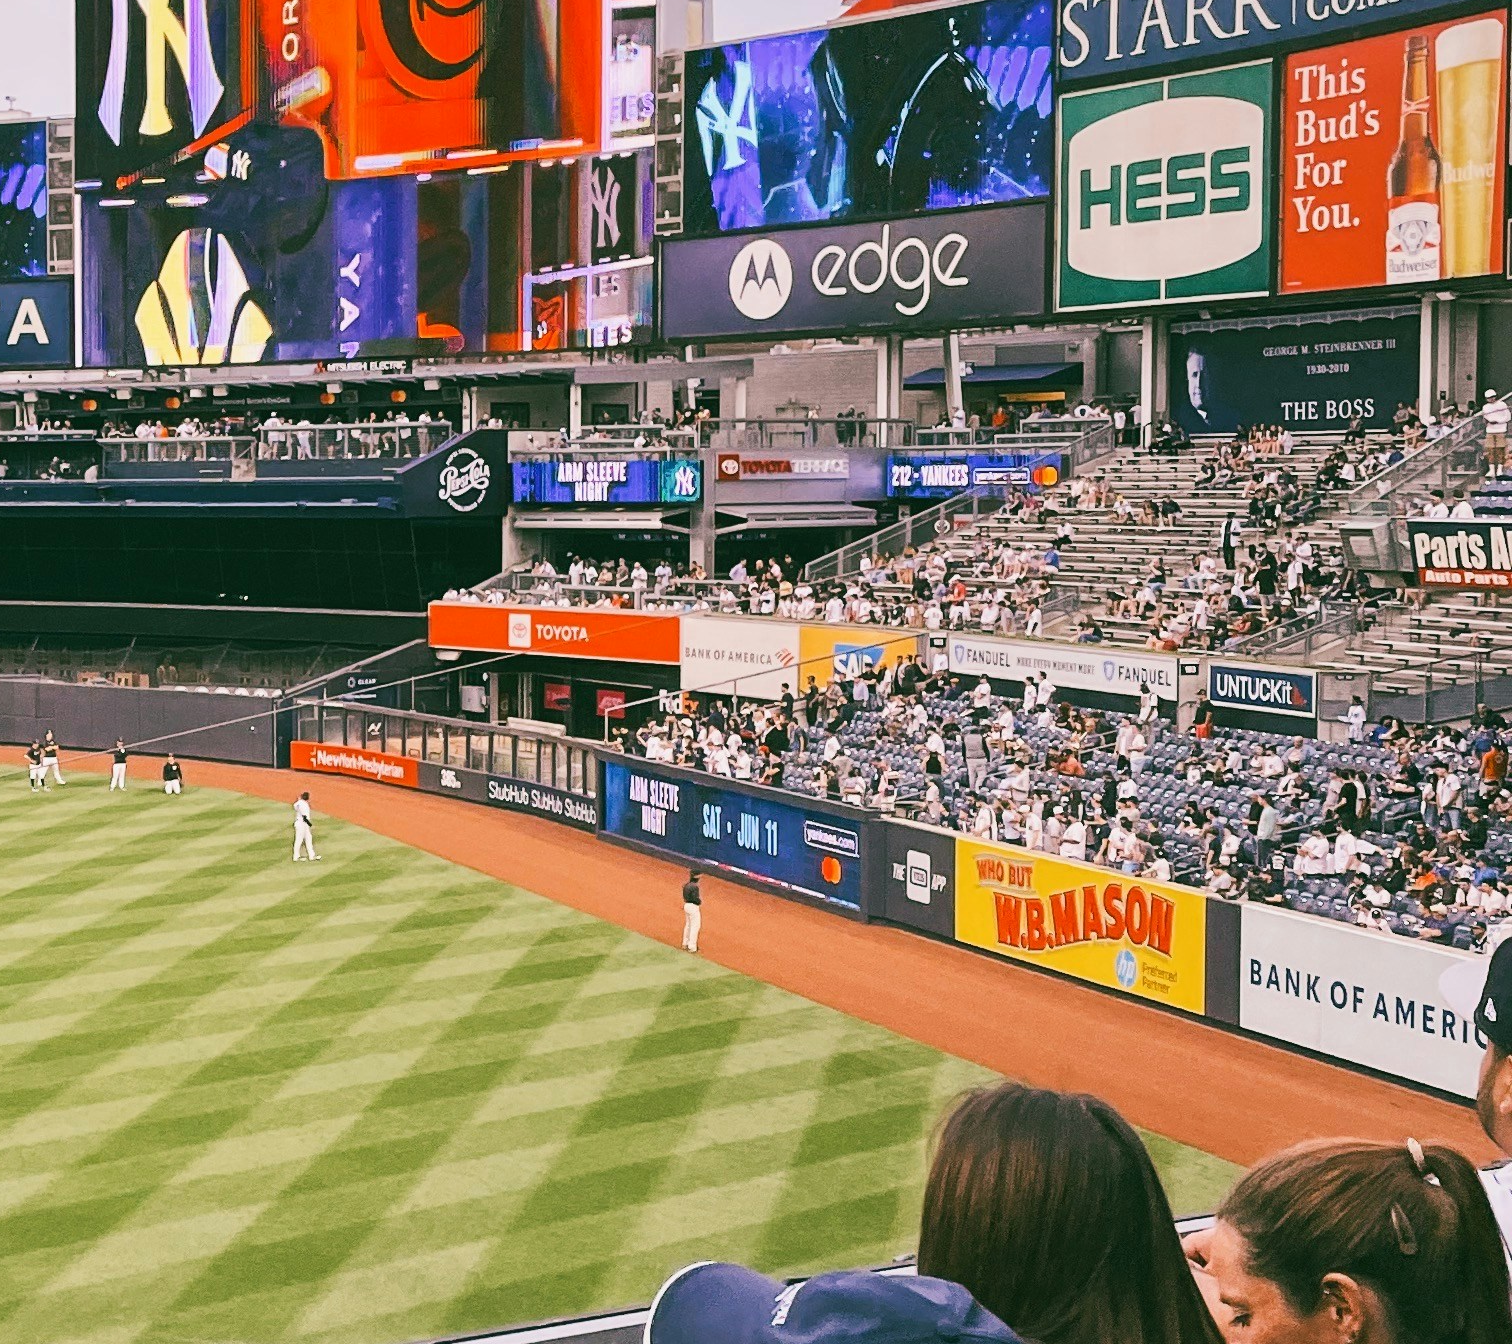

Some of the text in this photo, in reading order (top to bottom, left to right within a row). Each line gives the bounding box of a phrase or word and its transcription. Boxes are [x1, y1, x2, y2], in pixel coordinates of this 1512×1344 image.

[1294, 58, 1366, 104] This
[1294, 103, 1381, 147] Bud's
[1293, 152, 1347, 191] For
[1080, 146, 1250, 230] HESS
[1292, 197, 1361, 233] You.
[812, 224, 969, 315] edge
[1280, 398, 1375, 420] THE BOSS
[558, 461, 626, 482] ARM SLEEVE
[574, 481, 610, 502] NIGHT
[1414, 526, 1512, 571] Parts A
[1425, 569, 1510, 586] Auto Parts
[536, 623, 589, 642] TOYOTA
[685, 647, 773, 665] BANK OF AMERICA
[967, 649, 1011, 668] FANDUEL
[1118, 665, 1172, 687] FANDUEL
[1217, 673, 1293, 705] UNTUCKit
[488, 781, 596, 824] StubHub StubHub StubHub
[630, 774, 680, 812] ARM SLEEVE
[641, 809, 667, 836] NIGHT
[703, 803, 778, 856] SAT JUN 11
[892, 863, 905, 881] THE
[977, 859, 1033, 888] WHO BUT
[1142, 962, 1178, 983] Preferred
[1142, 976, 1171, 994] Partner
[1250, 958, 1321, 1003] BANK
[1330, 981, 1365, 1014] OF
